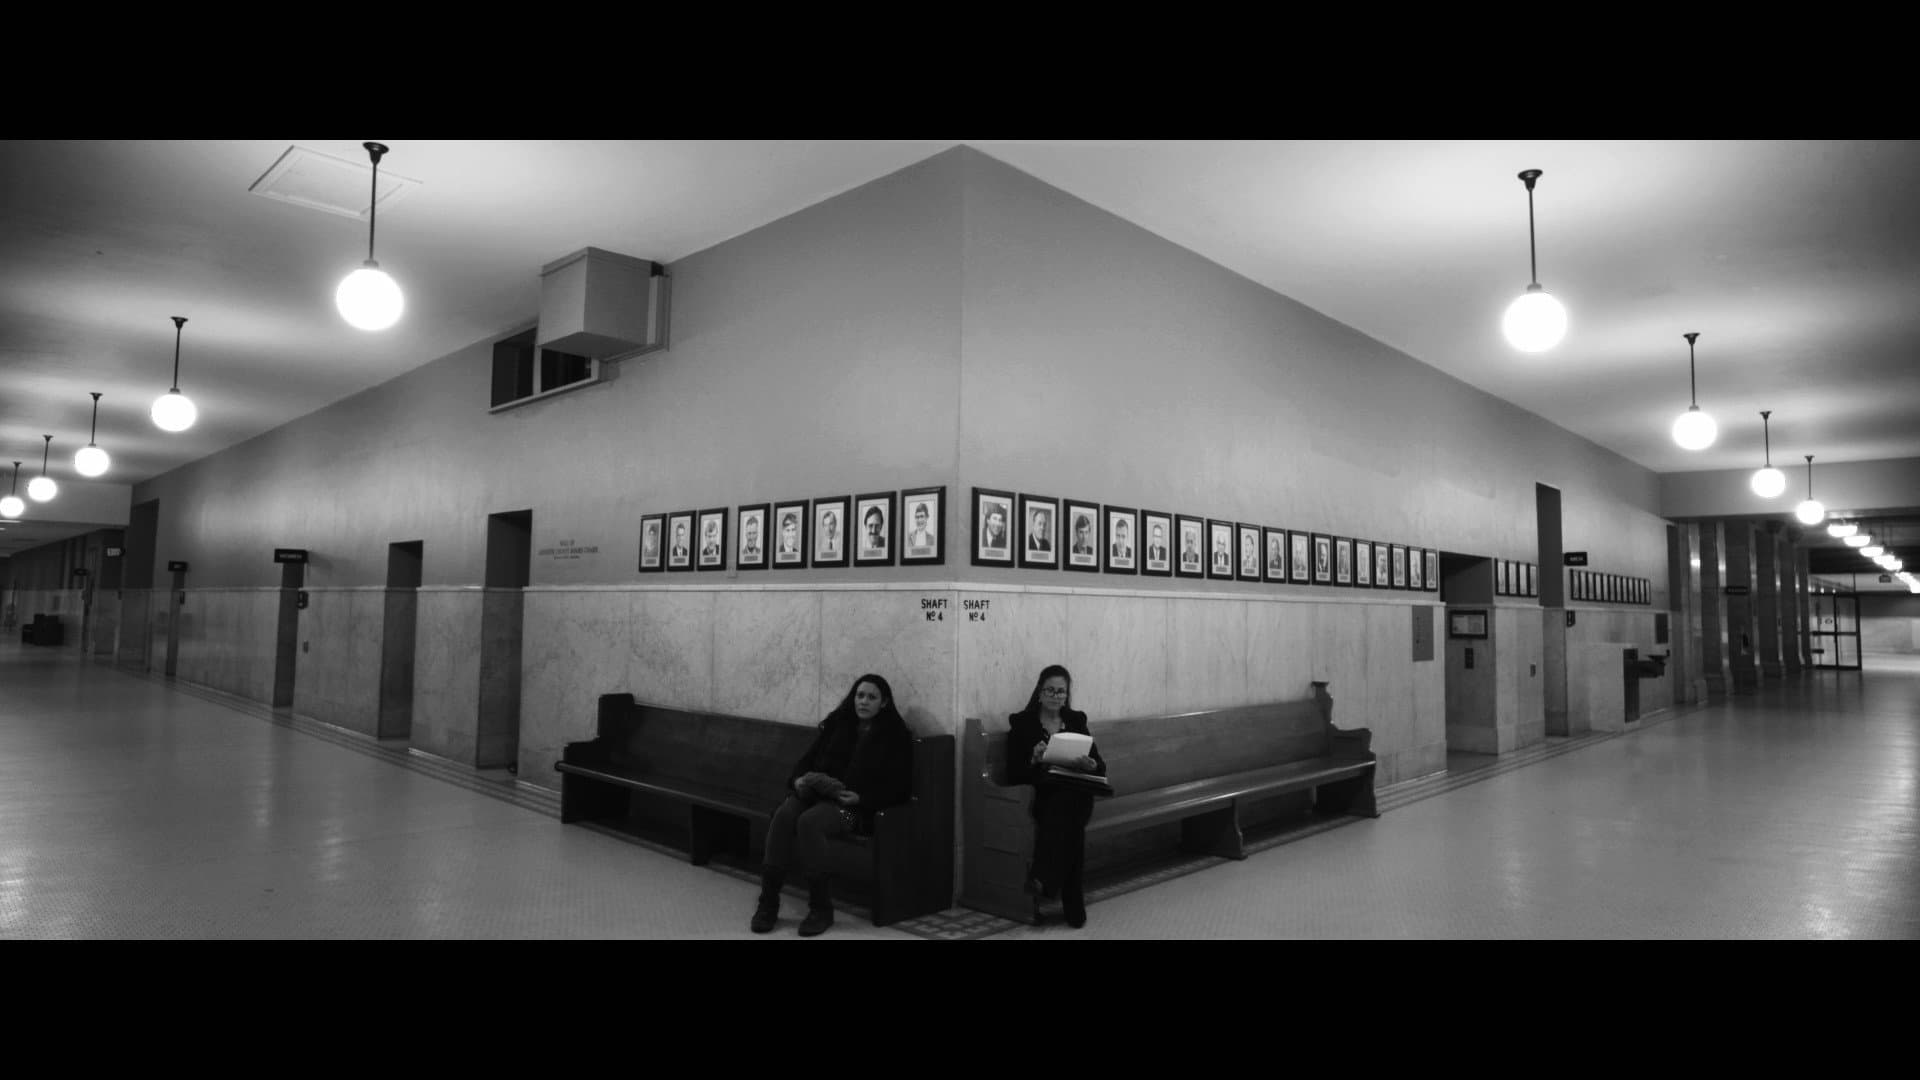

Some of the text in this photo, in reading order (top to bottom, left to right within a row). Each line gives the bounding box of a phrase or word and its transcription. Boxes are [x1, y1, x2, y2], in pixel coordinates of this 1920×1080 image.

[921, 599, 948, 609] SHAFT
[963, 600, 990, 610] SHAFT
[938, 611, 943, 621] 4
[980, 612, 986, 621] 4
